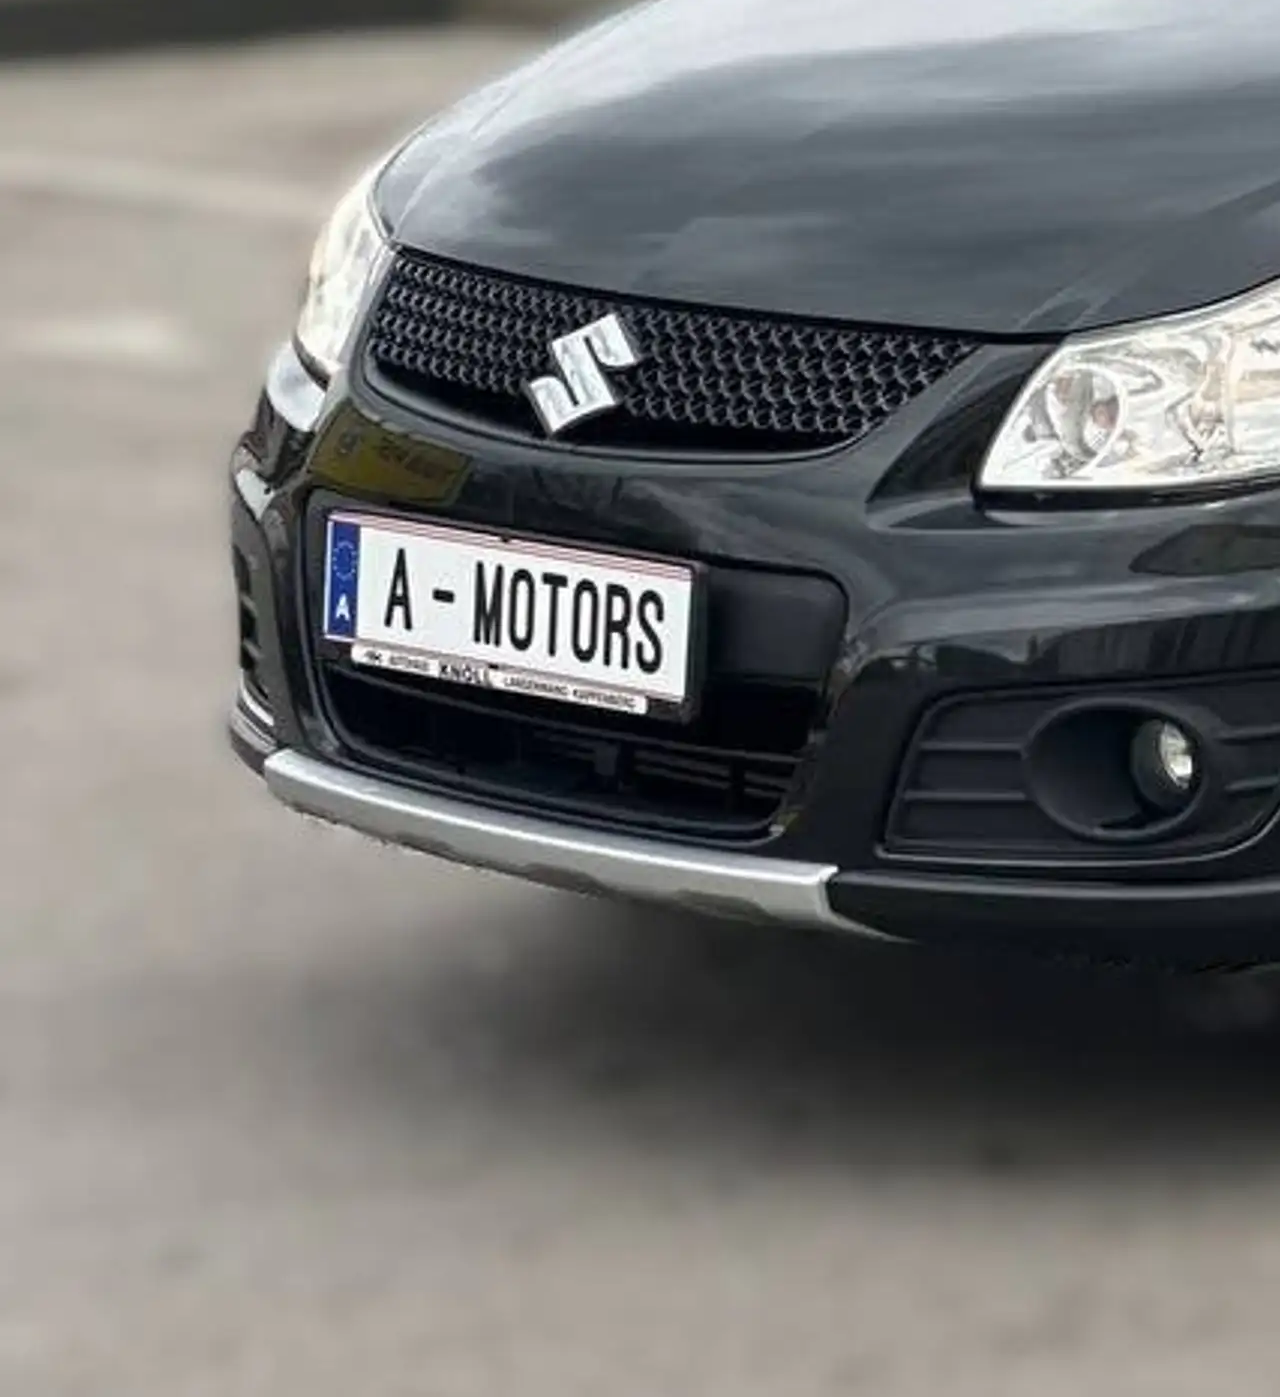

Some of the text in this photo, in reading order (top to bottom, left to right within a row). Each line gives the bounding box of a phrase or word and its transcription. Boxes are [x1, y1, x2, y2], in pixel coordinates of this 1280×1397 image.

[335, 593, 351, 621] A
[384, 547, 414, 632] A
[473, 560, 665, 674] MOTORS
